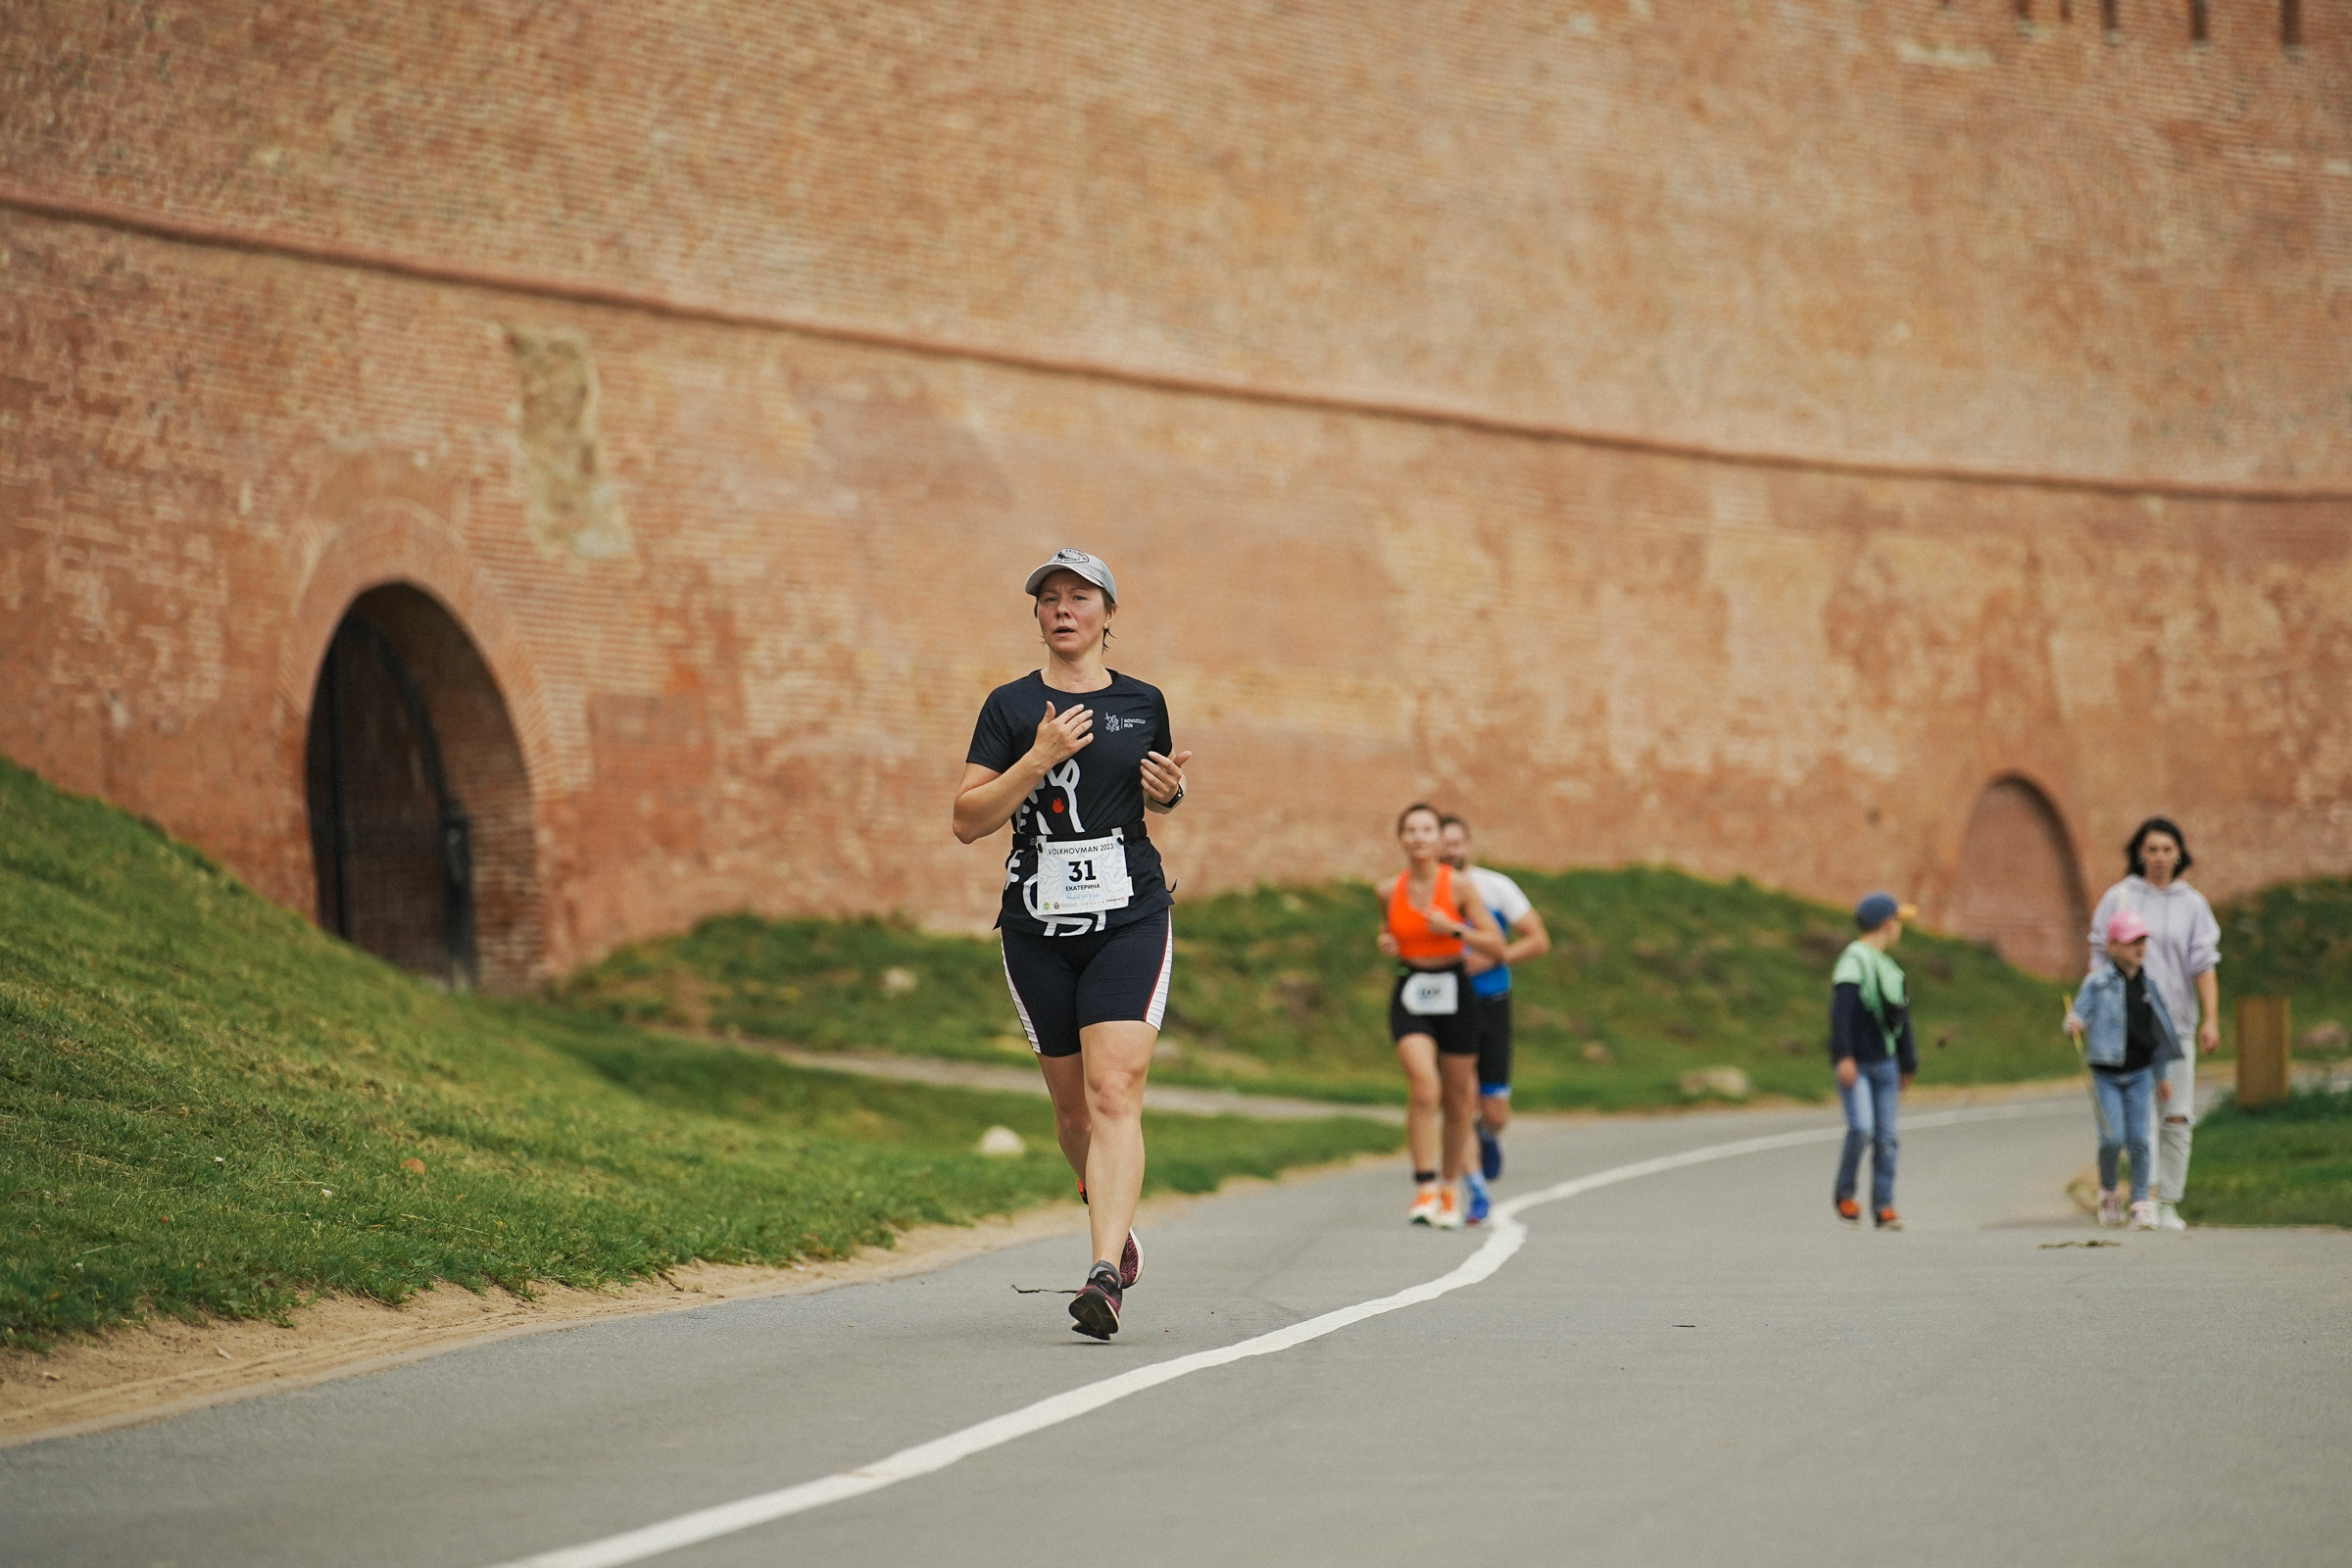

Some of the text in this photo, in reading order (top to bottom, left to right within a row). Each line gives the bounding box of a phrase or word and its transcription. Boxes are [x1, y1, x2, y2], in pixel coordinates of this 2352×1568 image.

[1048, 843, 1114, 856] VOLKHOVMAN 2023
[1068, 859, 1097, 883] 31
[1065, 883, 1101, 892] ЕКАТЕРИНА
